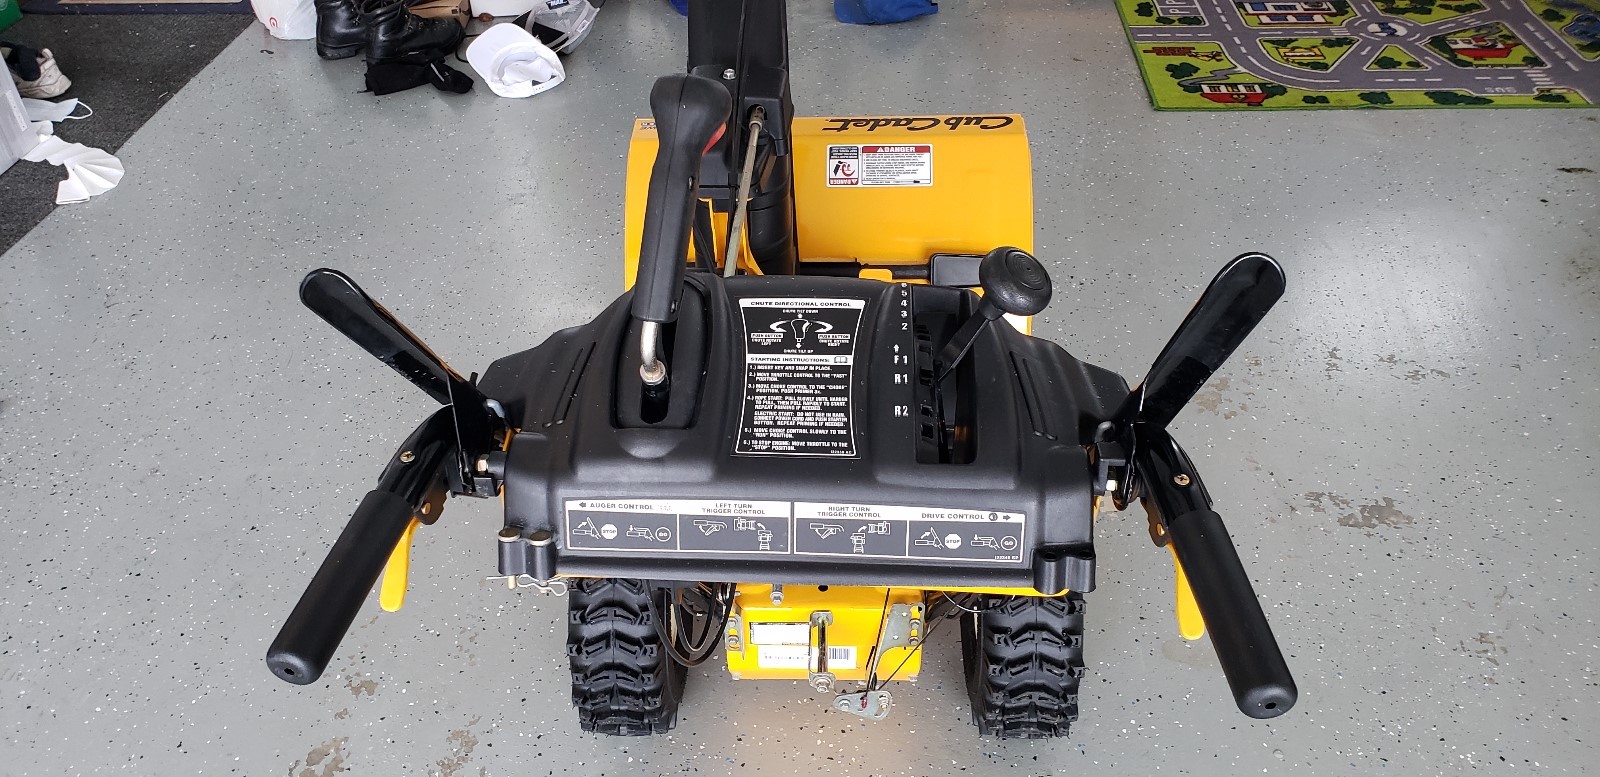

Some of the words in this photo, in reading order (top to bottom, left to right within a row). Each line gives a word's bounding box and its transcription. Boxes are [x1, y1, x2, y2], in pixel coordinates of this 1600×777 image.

[822, 116, 941, 132] Cadet
[944, 116, 1014, 130] Cub
[901, 322, 908, 330] 2
